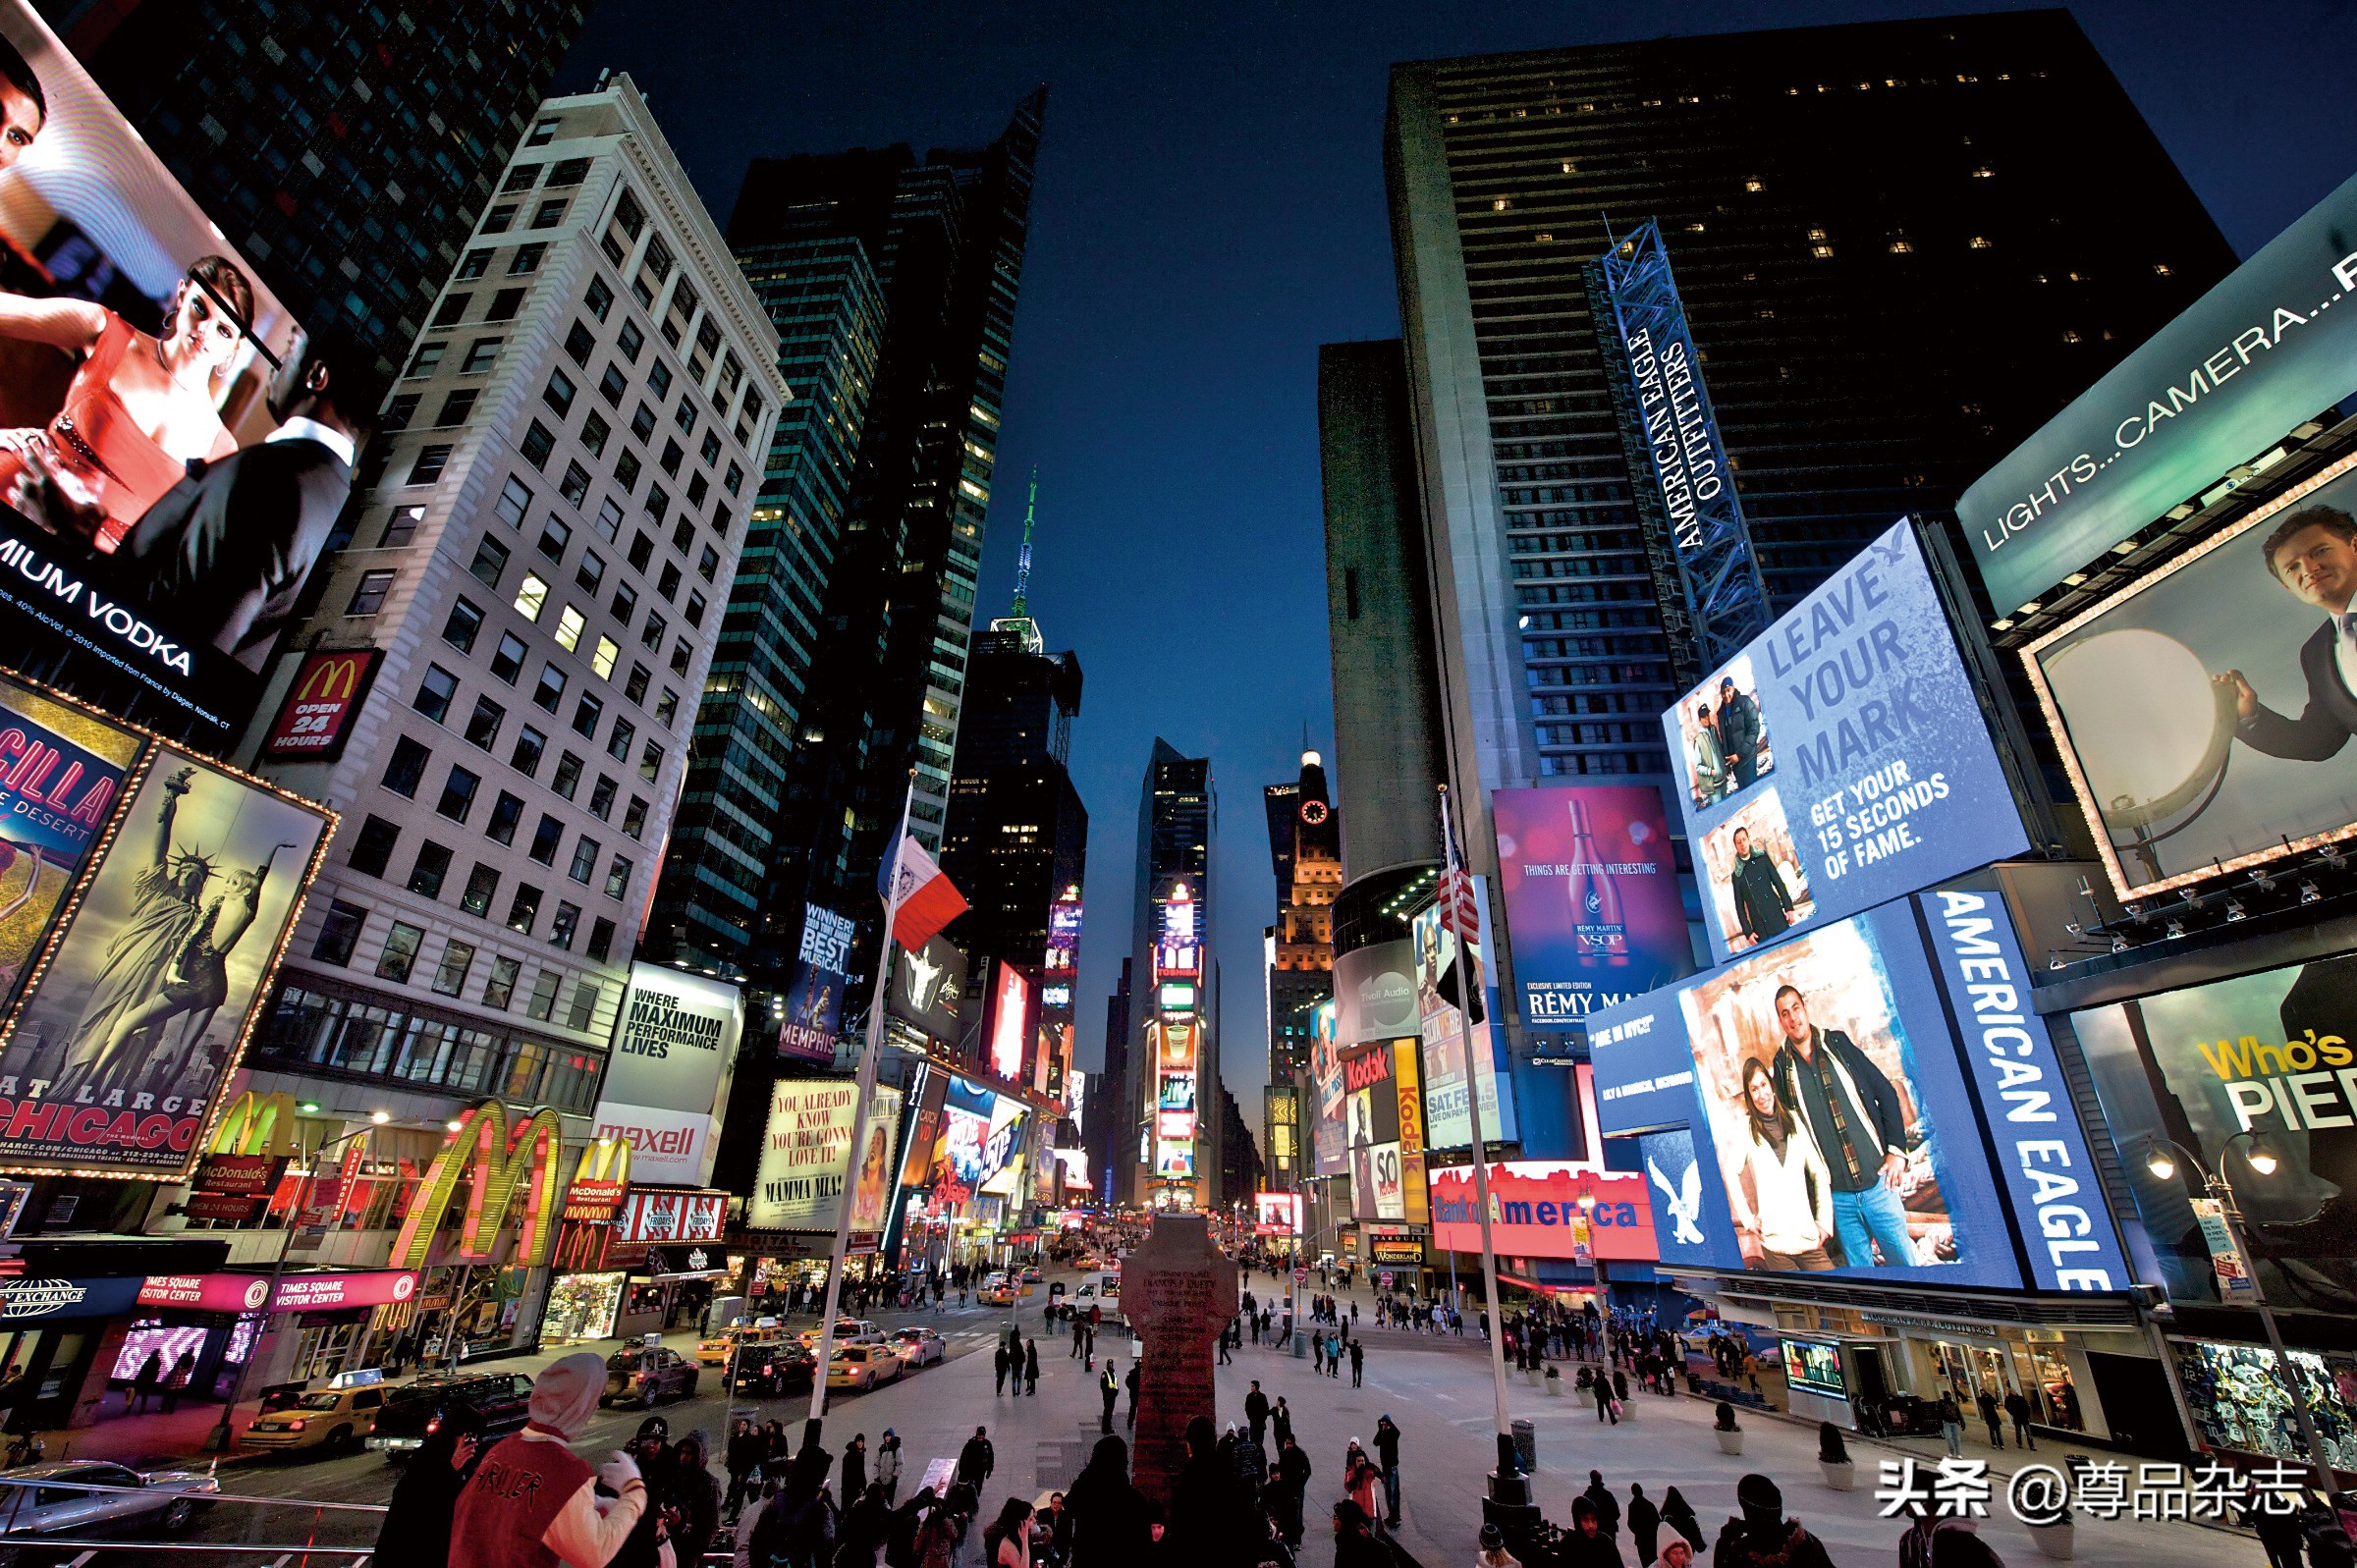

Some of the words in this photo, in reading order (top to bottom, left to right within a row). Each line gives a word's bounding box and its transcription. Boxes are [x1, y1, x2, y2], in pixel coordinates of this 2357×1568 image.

[1626, 327, 1665, 410] EAGLE
[1660, 342, 1723, 501] OUTFITTERS
[1647, 410, 1704, 550] AMERICAN
[1767, 557, 1890, 679] LEAVE
[89, 591, 190, 677] VODKA
[73, 633, 93, 649] 2010
[92, 645, 125, 669] Imported
[123, 662, 140, 677] from
[139, 673, 163, 691] France
[162, 685, 174, 697] by
[1788, 620, 1909, 724] YOUR
[295, 703, 342, 715] OPEN
[291, 715, 331, 733] 24
[1795, 676, 1927, 789] MARK
[274, 734, 333, 747] HOURS
[1810, 795, 1846, 828] GET
[1850, 758, 1912, 806] YOUR
[13, 800, 90, 841] DESERT
[1817, 825, 1843, 854] 15
[1846, 772, 1949, 841] SECONDS
[1824, 850, 1850, 881] OF
[1854, 822, 1922, 869] FAME.
[1524, 864, 1554, 877] THINGS
[1555, 864, 1570, 876] ARE
[1571, 863, 1605, 876] GETTING
[1606, 862, 1657, 875] INTERESTING
[806, 901, 855, 935] WINNER!
[801, 926, 850, 963] BEST
[1578, 934, 1622, 946] VSOP
[798, 947, 845, 976] MUSICAL
[1158, 968, 1198, 977] TOSHIBA
[634, 988, 680, 1009] WHERE
[1361, 991, 1382, 1001] Tivoli
[1383, 987, 1410, 999] Audio
[1528, 992, 1594, 1015] RÉMY
[629, 1001, 723, 1038] MAXIMUM
[620, 1035, 669, 1059] LIVES
[626, 1021, 719, 1051] PERFORMANCE
[779, 1022, 837, 1054] MEMPHIS
[2194, 1028, 2354, 1081] Who's
[1346, 1045, 1390, 1090] Kodak
[0, 1075, 52, 1099] AT
[75, 1084, 208, 1116] LARGE
[778, 1095, 800, 1113] YOU
[802, 1089, 853, 1110] ALREADY
[1428, 1092, 1453, 1114] SAT.
[1936, 891, 2057, 1123] AMERICAN
[2016, 1140, 2113, 1292] EAGLE
[796, 1109, 832, 1129] KNOW
[1429, 1113, 1442, 1123] LIVE
[1442, 1111, 1452, 1120] ON
[1452, 1101, 1497, 1118] PAY-P-VIEW
[596, 1124, 695, 1155] maxell
[772, 1129, 813, 1150] YOU'RE
[816, 1125, 854, 1146] GONNA
[1398, 1086, 1422, 1174] Kodak
[347, 1152, 359, 1177] OPEN
[789, 1147, 817, 1167] LOVE
[821, 1145, 837, 1163] IT!
[1377, 1149, 1398, 1184] SO
[197, 1165, 268, 1180] McDonald's
[204, 1179, 252, 1188] Restaurant
[332, 1185, 348, 1217] HOURS
[569, 1186, 622, 1197] McDonald's
[764, 1179, 810, 1204] MAMMA
[814, 1174, 842, 1198] MIA!
[221, 1204, 249, 1213] HOURS
[649, 1216, 672, 1226] FRIDAYS
[1434, 1195, 1469, 1223] Bank
[1489, 1192, 1638, 1227] Amerca
[692, 1217, 712, 1226] FRIDAYS
[1375, 1252, 1422, 1263] WONDERLAND
[168, 1277, 201, 1289] SQUARE
[280, 1282, 308, 1294] TIMES
[308, 1280, 344, 1294] SQUARE
[14, 1289, 86, 1303] EXCHANGE
[169, 1290, 201, 1302] CENTER
[276, 1294, 310, 1307] VISITOR
[311, 1292, 345, 1304] CENTER
[1867, 1313, 1907, 1325] AMERICAN
[1908, 1317, 1935, 1327] EAGLE
